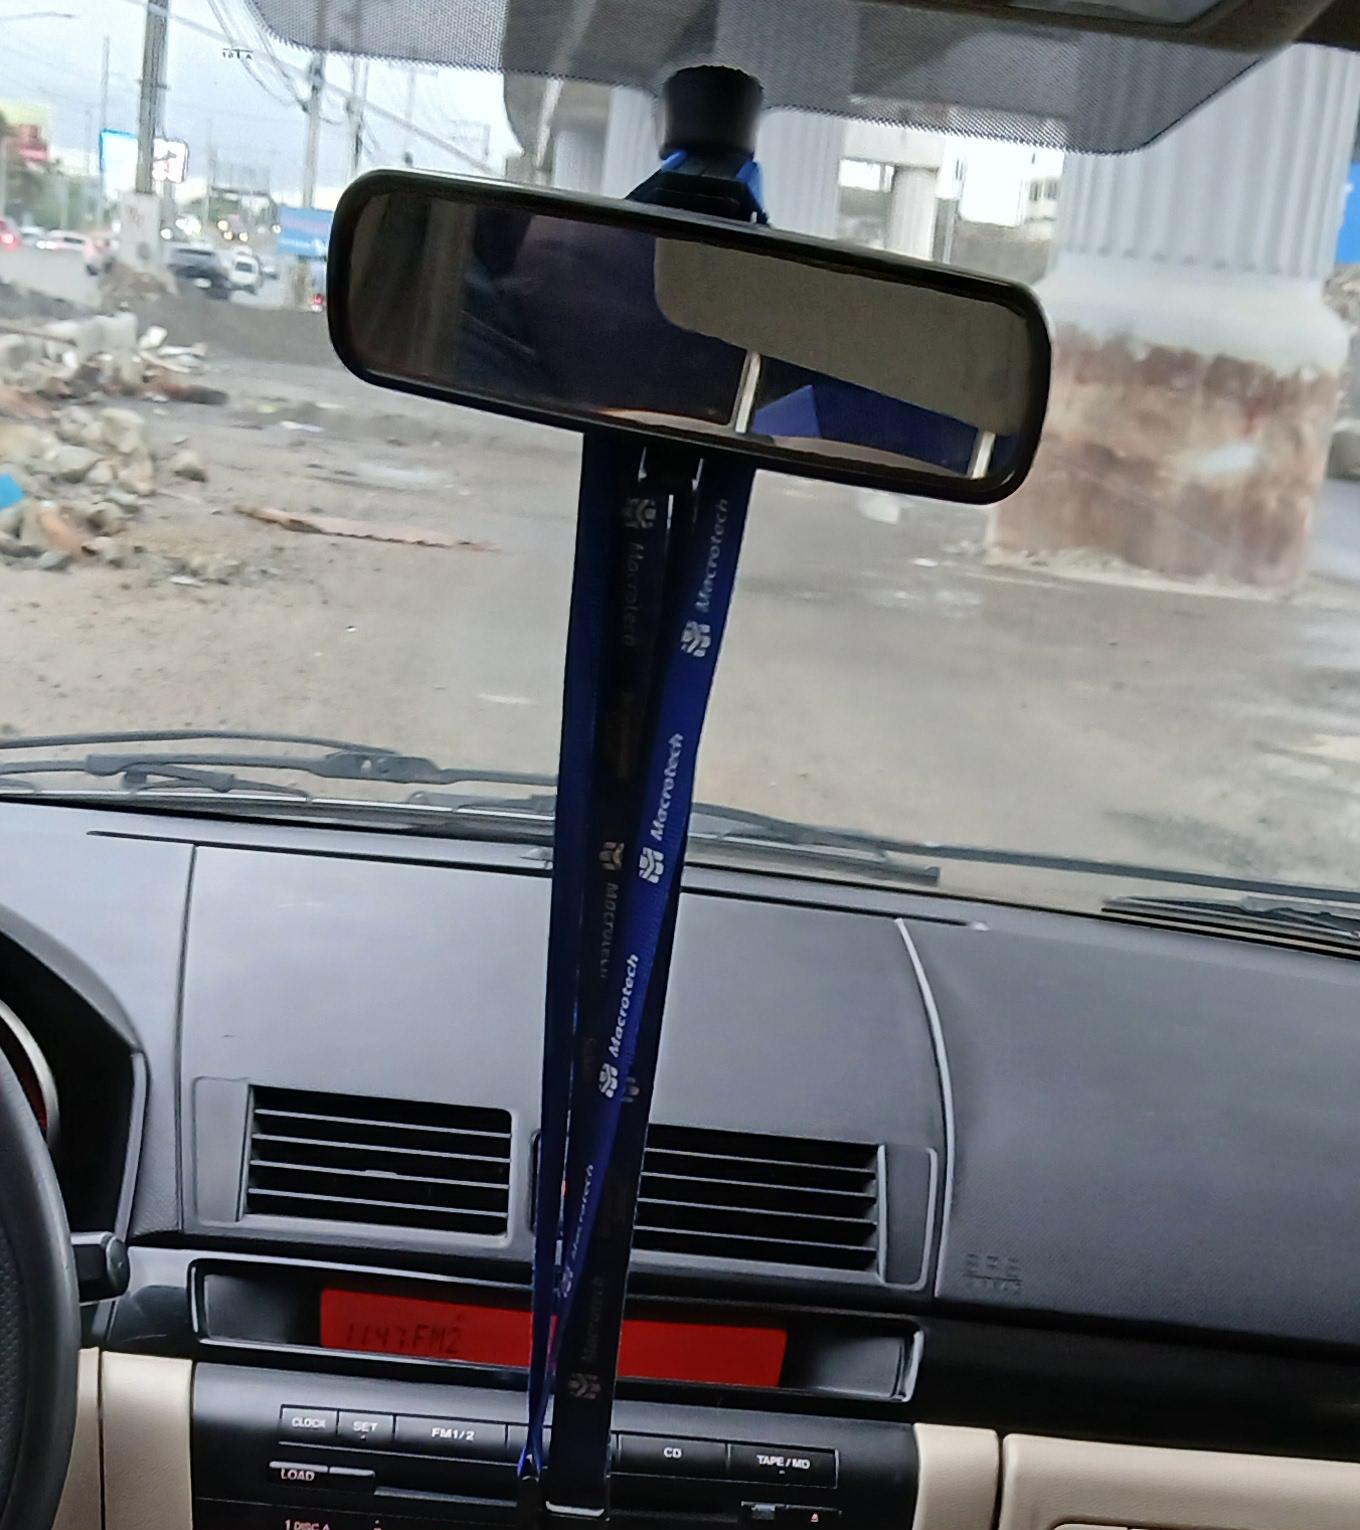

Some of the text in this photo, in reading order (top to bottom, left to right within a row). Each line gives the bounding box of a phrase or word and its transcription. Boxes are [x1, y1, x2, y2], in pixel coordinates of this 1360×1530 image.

[694, 497, 729, 613] Macrotech
[649, 732, 684, 842] Macrotech
[607, 953, 640, 1059] Macrotech
[291, 1416, 327, 1430] CLOCK
[352, 1420, 379, 1432] SET
[431, 1427, 476, 1441] FM1/2
[663, 1447, 682, 1459] CD
[280, 1467, 316, 1482] LOAD
